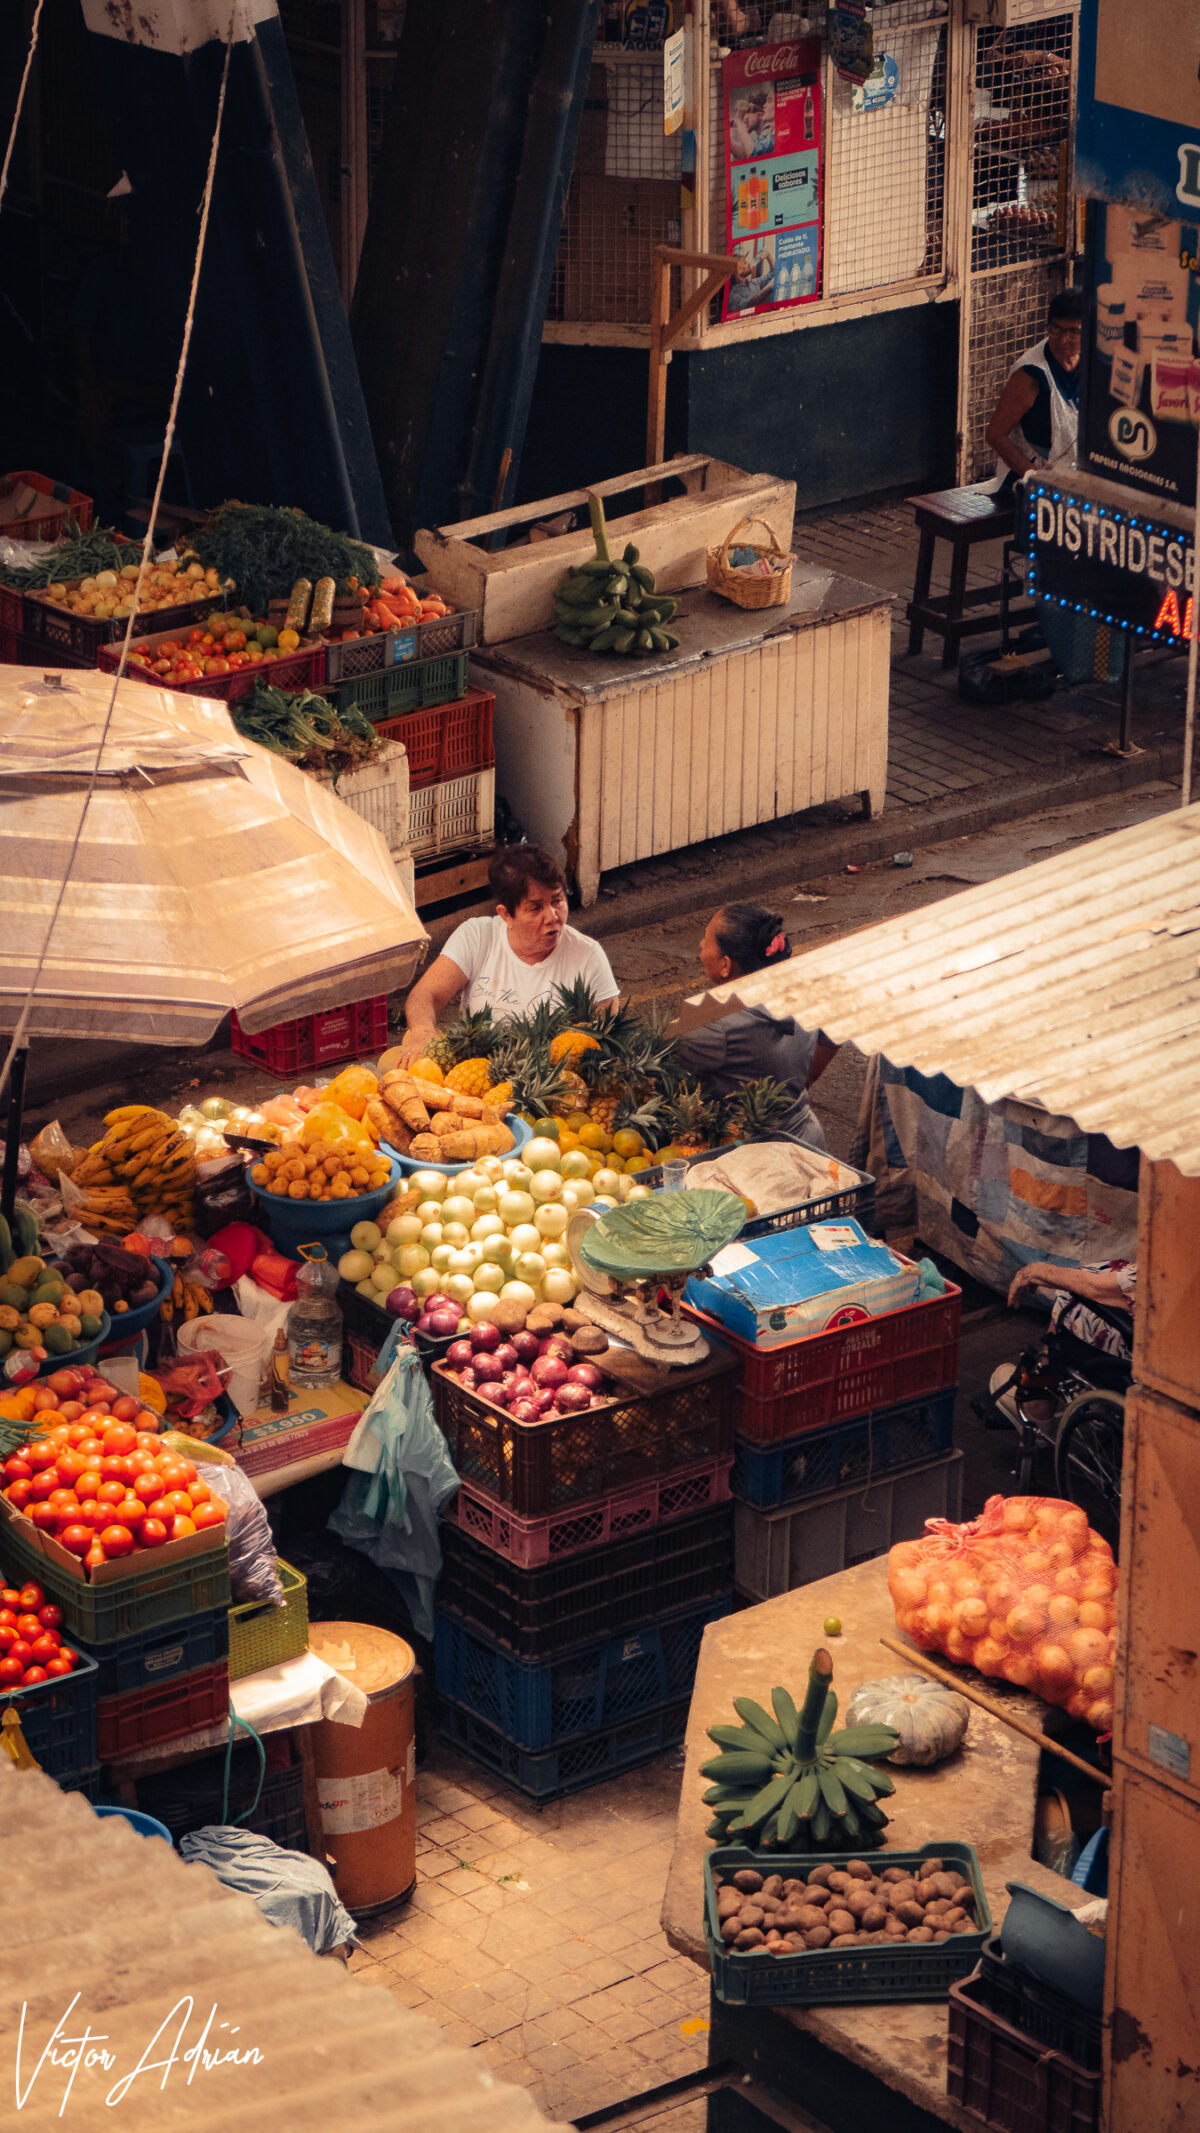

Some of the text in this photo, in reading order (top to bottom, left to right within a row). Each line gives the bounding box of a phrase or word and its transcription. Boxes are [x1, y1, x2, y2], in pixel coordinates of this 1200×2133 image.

[774, 170, 806, 182] Deliciosos
[778, 178, 802, 189] sabores
[778, 237, 794, 245] Cuida
[1089, 451, 1118, 469] PAPELES
[253, 1413, 316, 1437] $3.950
